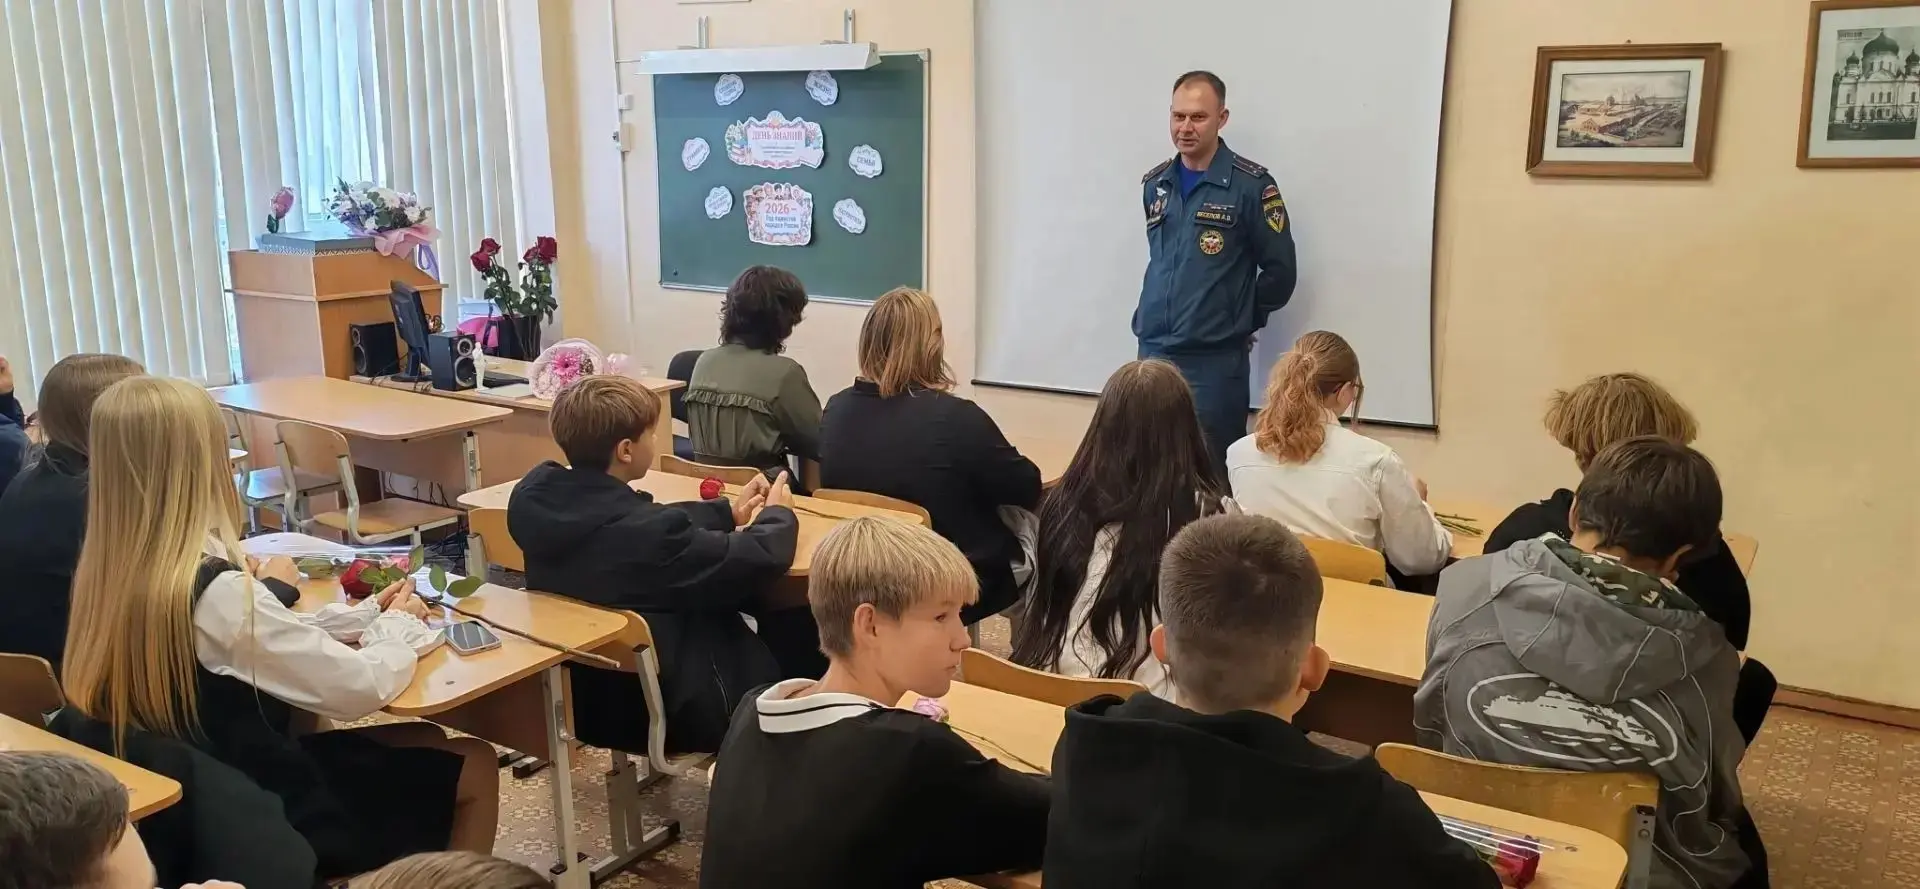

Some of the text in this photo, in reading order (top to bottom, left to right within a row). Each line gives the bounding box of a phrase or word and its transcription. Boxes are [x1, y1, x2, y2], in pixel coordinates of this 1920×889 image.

[752, 130, 803, 140] ДЕНЬ ЗНАНИЙ
[765, 202, 789, 214] 2026
